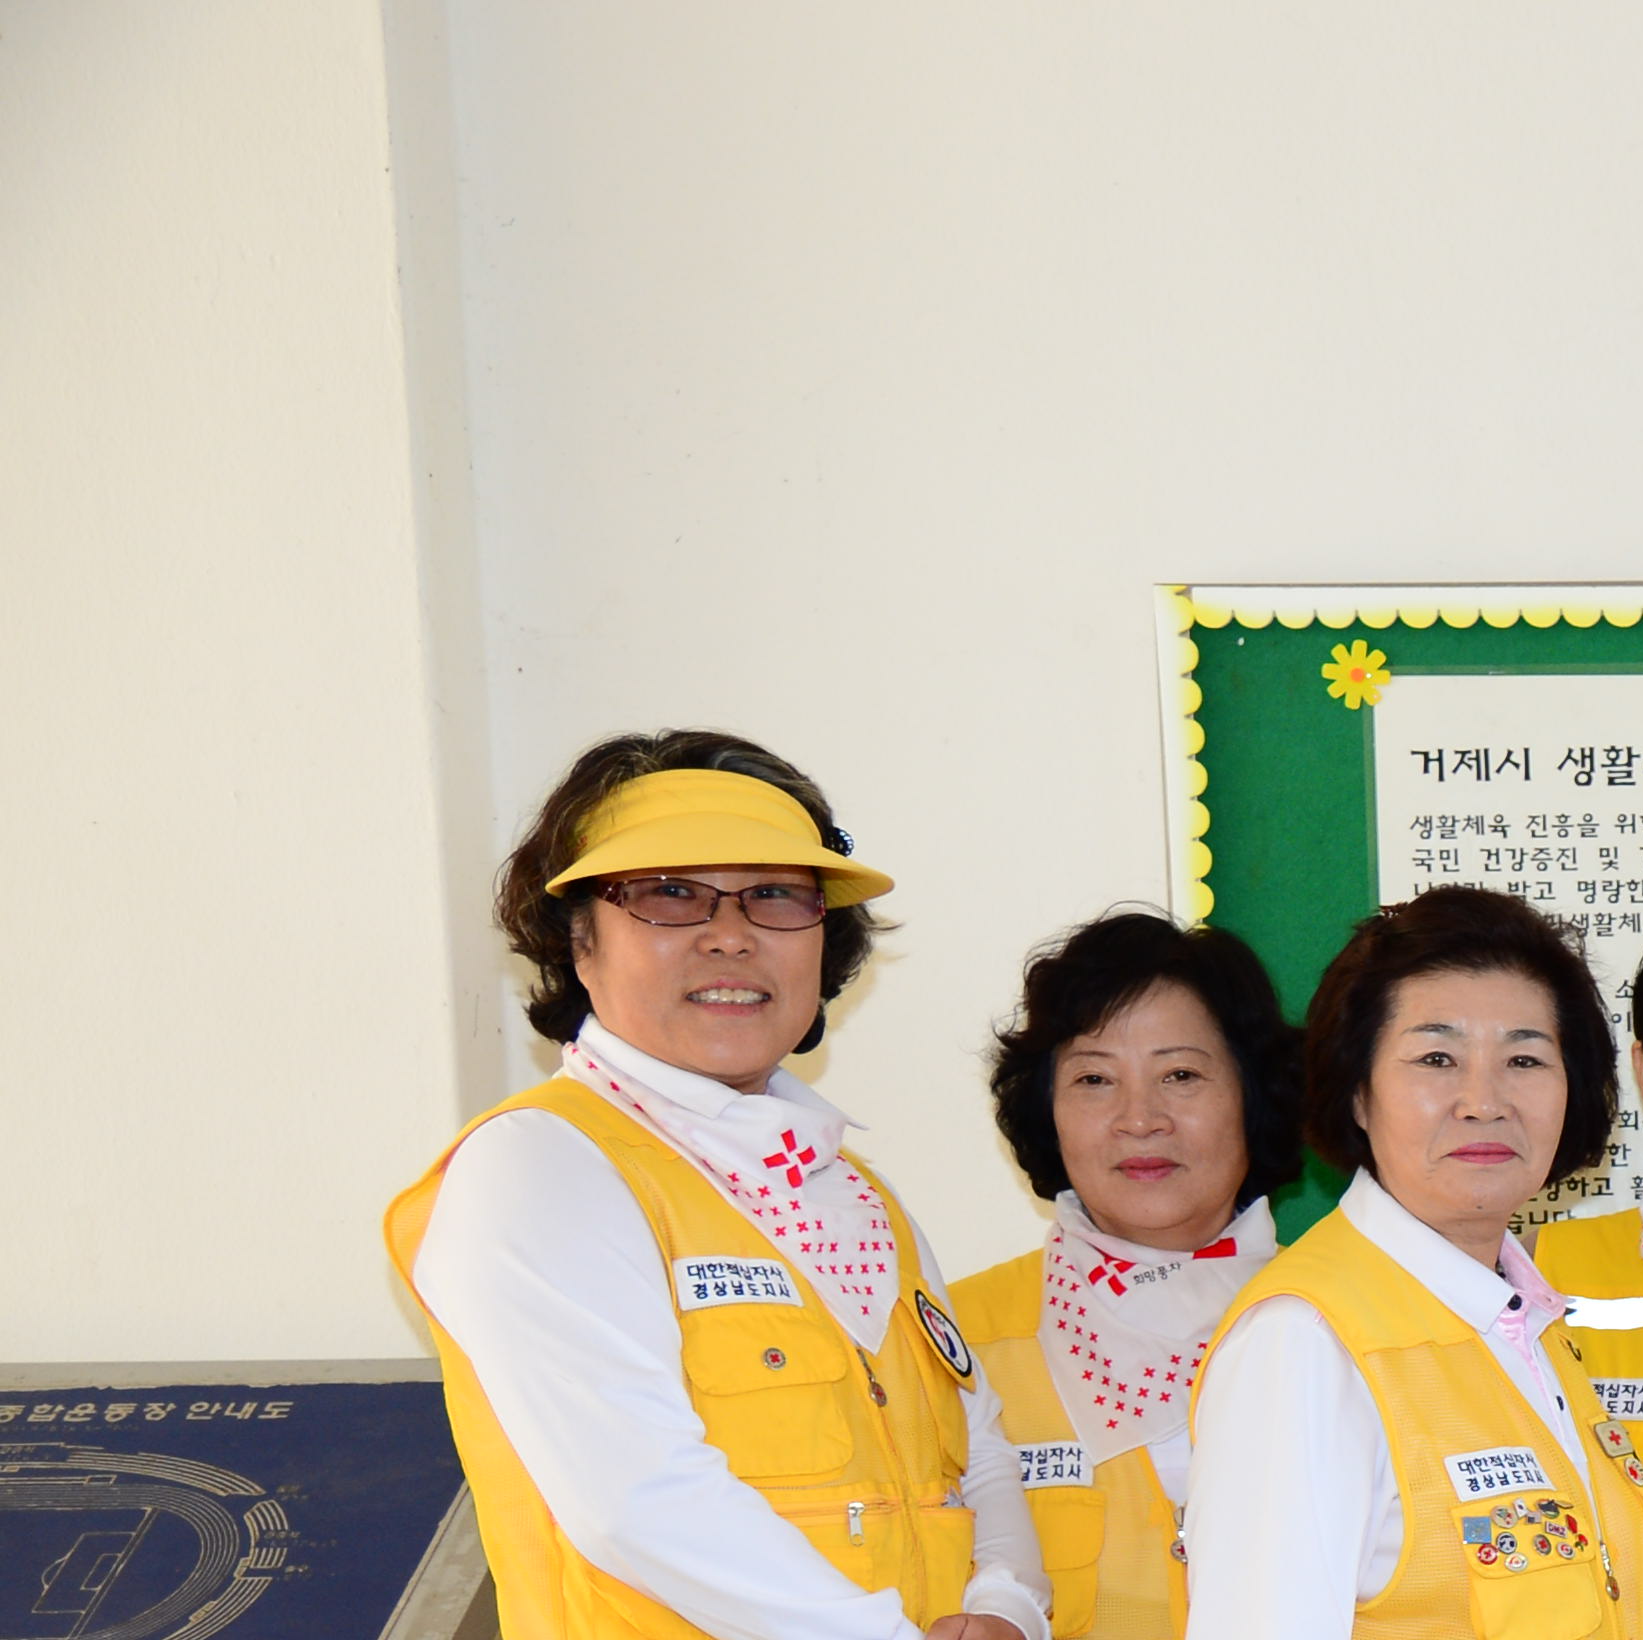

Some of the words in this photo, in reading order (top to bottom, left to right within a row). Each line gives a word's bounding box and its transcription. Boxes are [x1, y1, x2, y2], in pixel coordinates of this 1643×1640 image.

[1410, 746, 1532, 782] 거제시
[1409, 813, 1511, 841] 생활체육
[1525, 813, 1600, 839] 진흥을
[1412, 846, 1461, 873] 국민
[1479, 845, 1578, 873] 건강증진
[1599, 846, 1620, 871] 및
[686, 1262, 785, 1282] 대한적십자사
[693, 1280, 792, 1300] 경상남도지사
[185, 1401, 294, 1421] 안내도
[1019, 1447, 1084, 1465] 적십자사
